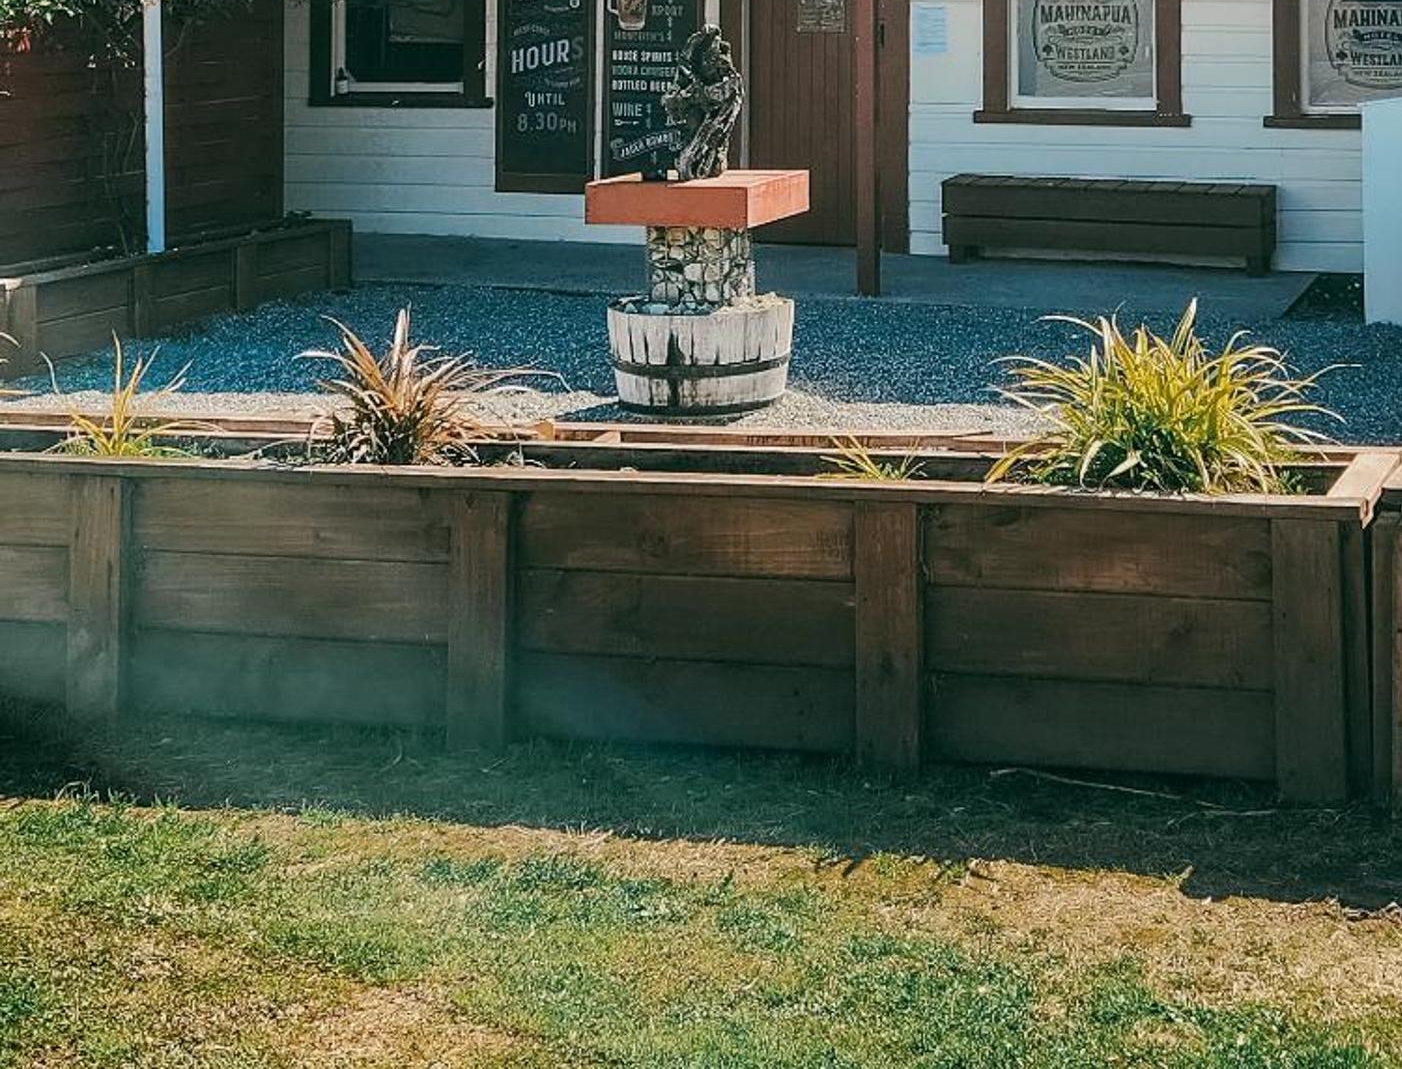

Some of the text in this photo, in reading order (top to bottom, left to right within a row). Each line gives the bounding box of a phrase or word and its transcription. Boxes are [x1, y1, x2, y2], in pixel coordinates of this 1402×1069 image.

[1040, 4, 1132, 25] MAHINAPUA
[1056, 45, 1116, 60] WESTLAND
[612, 79, 648, 91] BOTTLED
[525, 91, 566, 107] UNTIL
[612, 102, 643, 117] WINE
